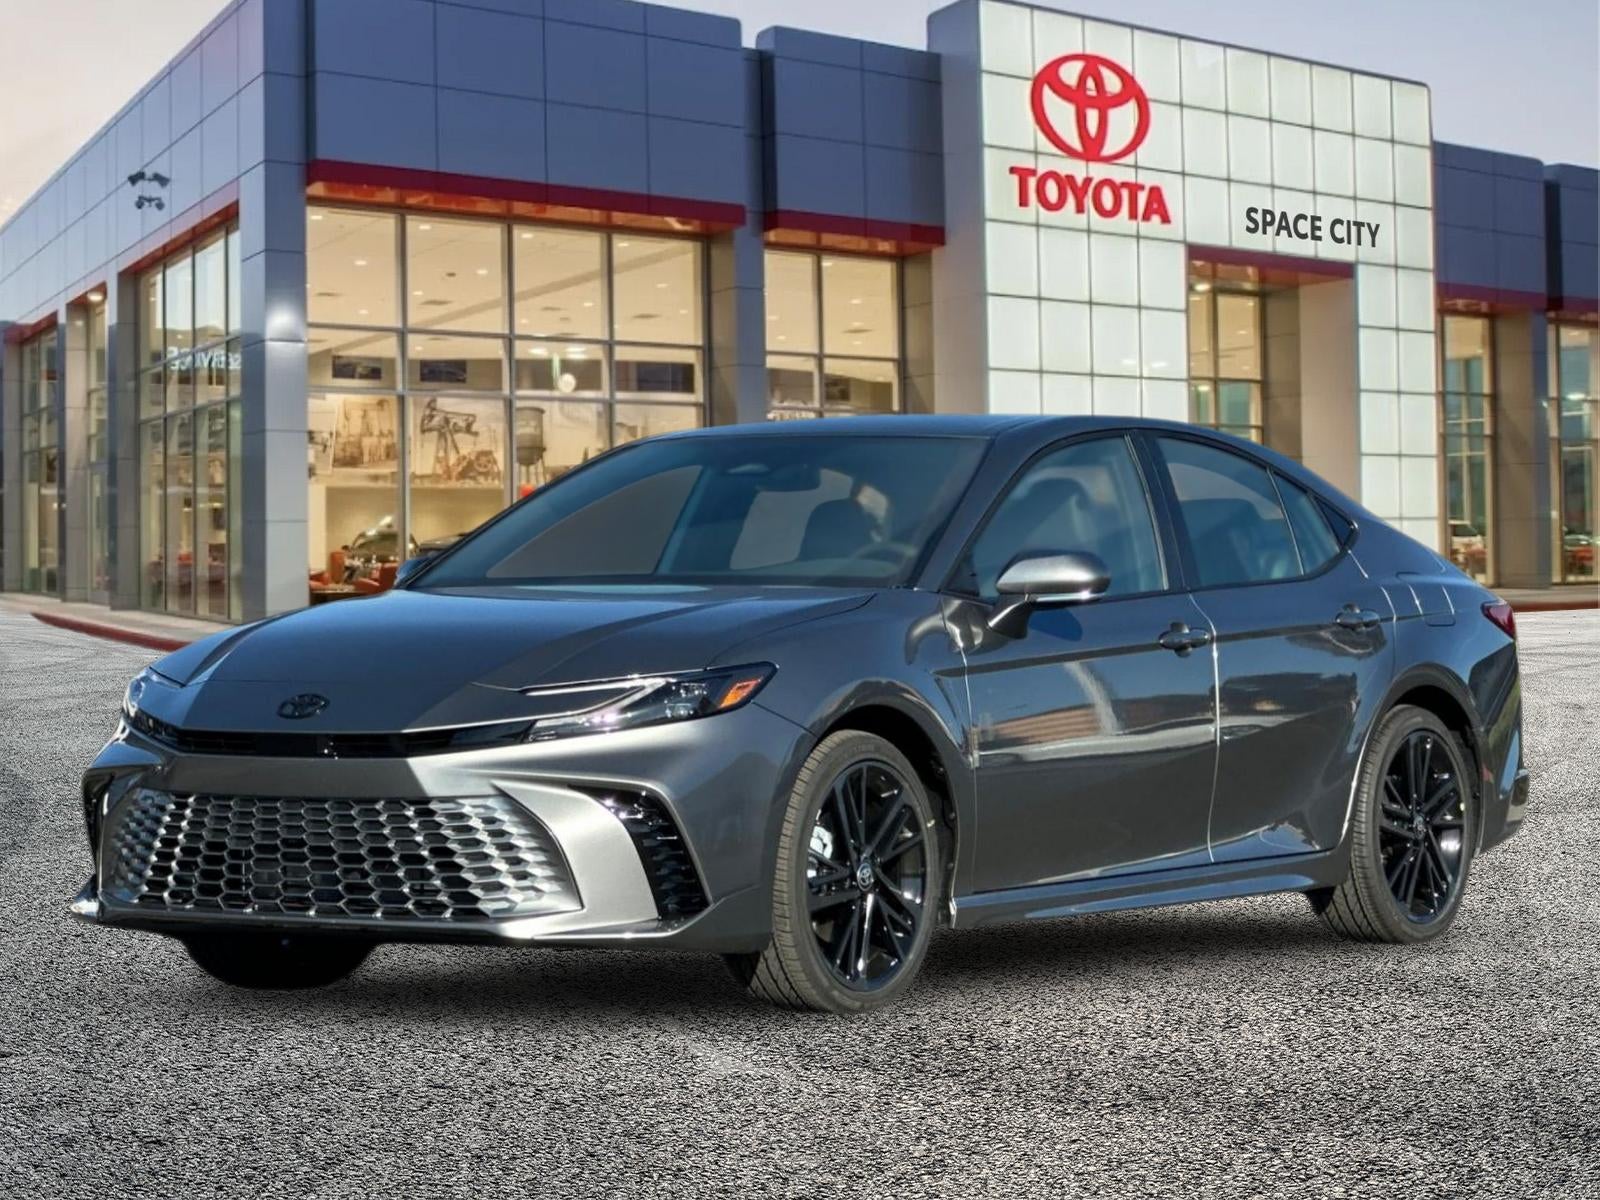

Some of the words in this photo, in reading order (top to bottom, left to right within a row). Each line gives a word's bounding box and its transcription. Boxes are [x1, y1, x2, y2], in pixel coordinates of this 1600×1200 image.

[1009, 165, 1172, 225] TOYOTA
[1245, 206, 1322, 242] SPACE
[1329, 217, 1381, 249] CITY
